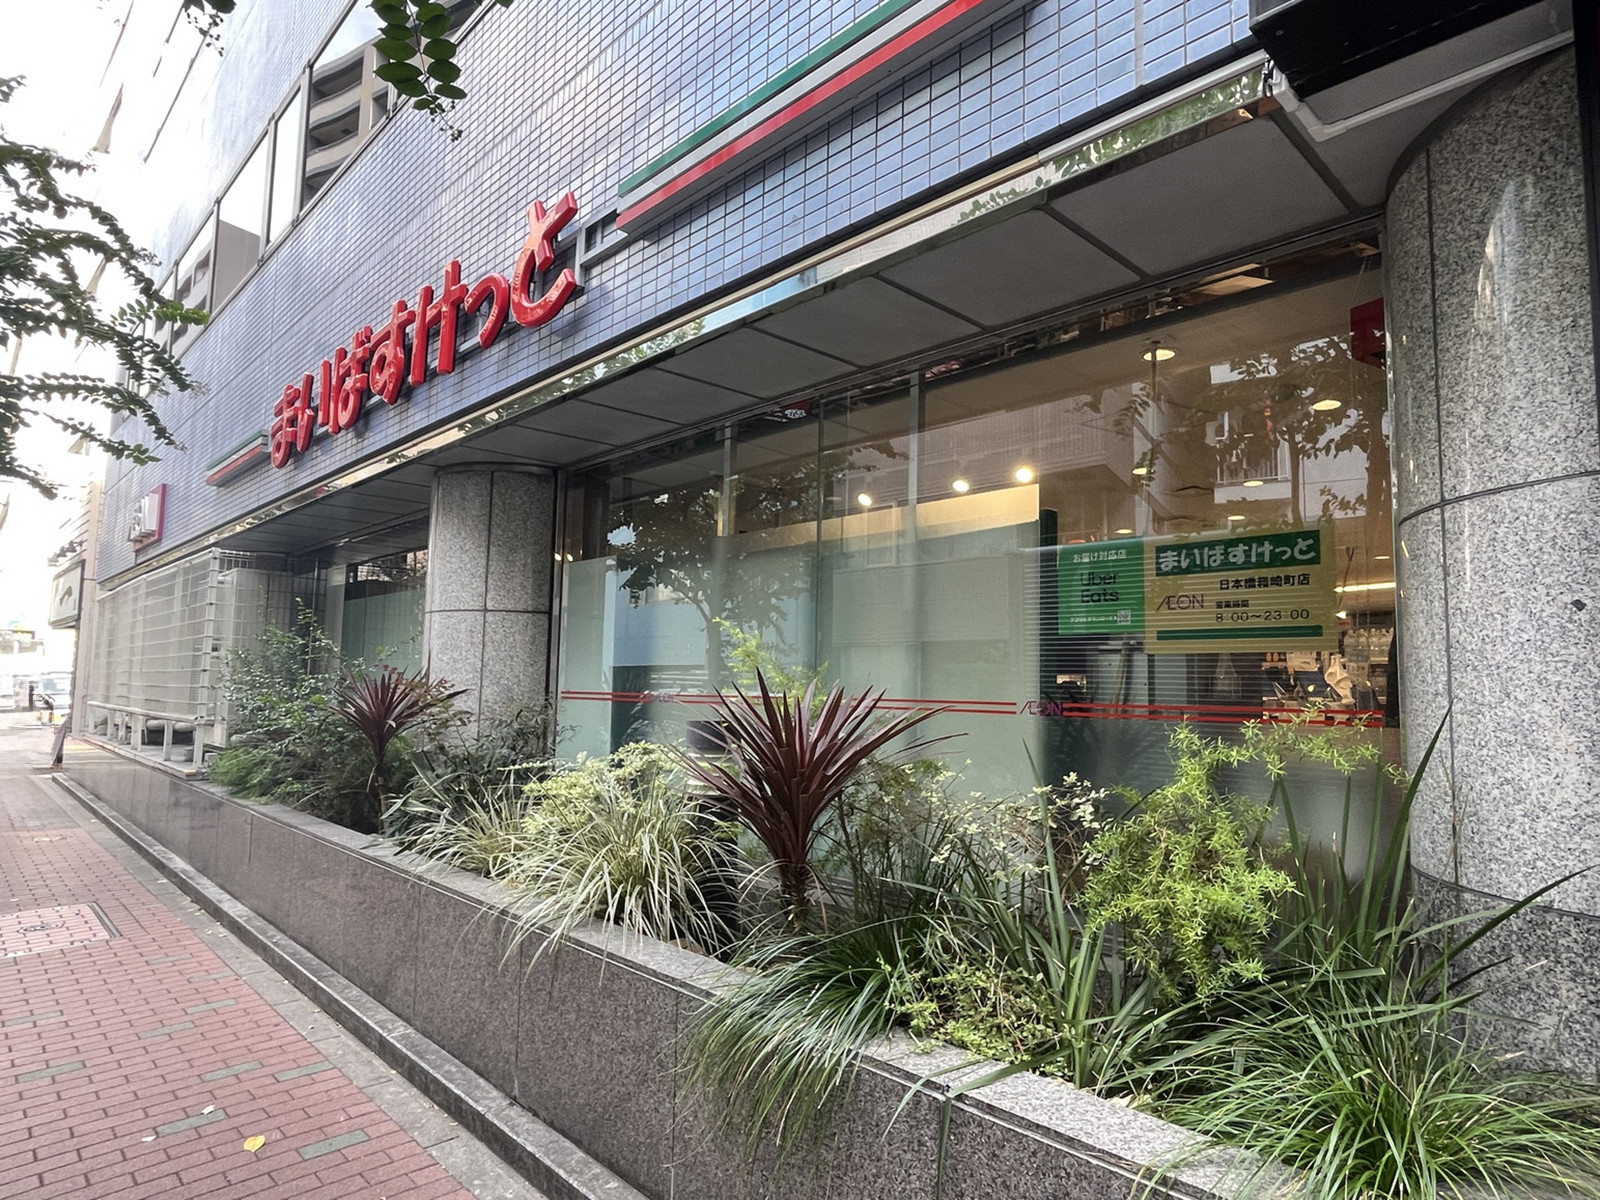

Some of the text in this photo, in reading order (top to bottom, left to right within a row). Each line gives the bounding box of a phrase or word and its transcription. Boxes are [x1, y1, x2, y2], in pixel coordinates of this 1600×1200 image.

[270, 191, 578, 470] まいばすけっと
[1073, 549, 1127, 563] お届け対応店
[1158, 538, 1316, 571] まいばすけっと
[1080, 571, 1117, 587] Uber
[1219, 573, 1311, 591] 日本橋箱崎町店
[1080, 588, 1120, 604] Eats
